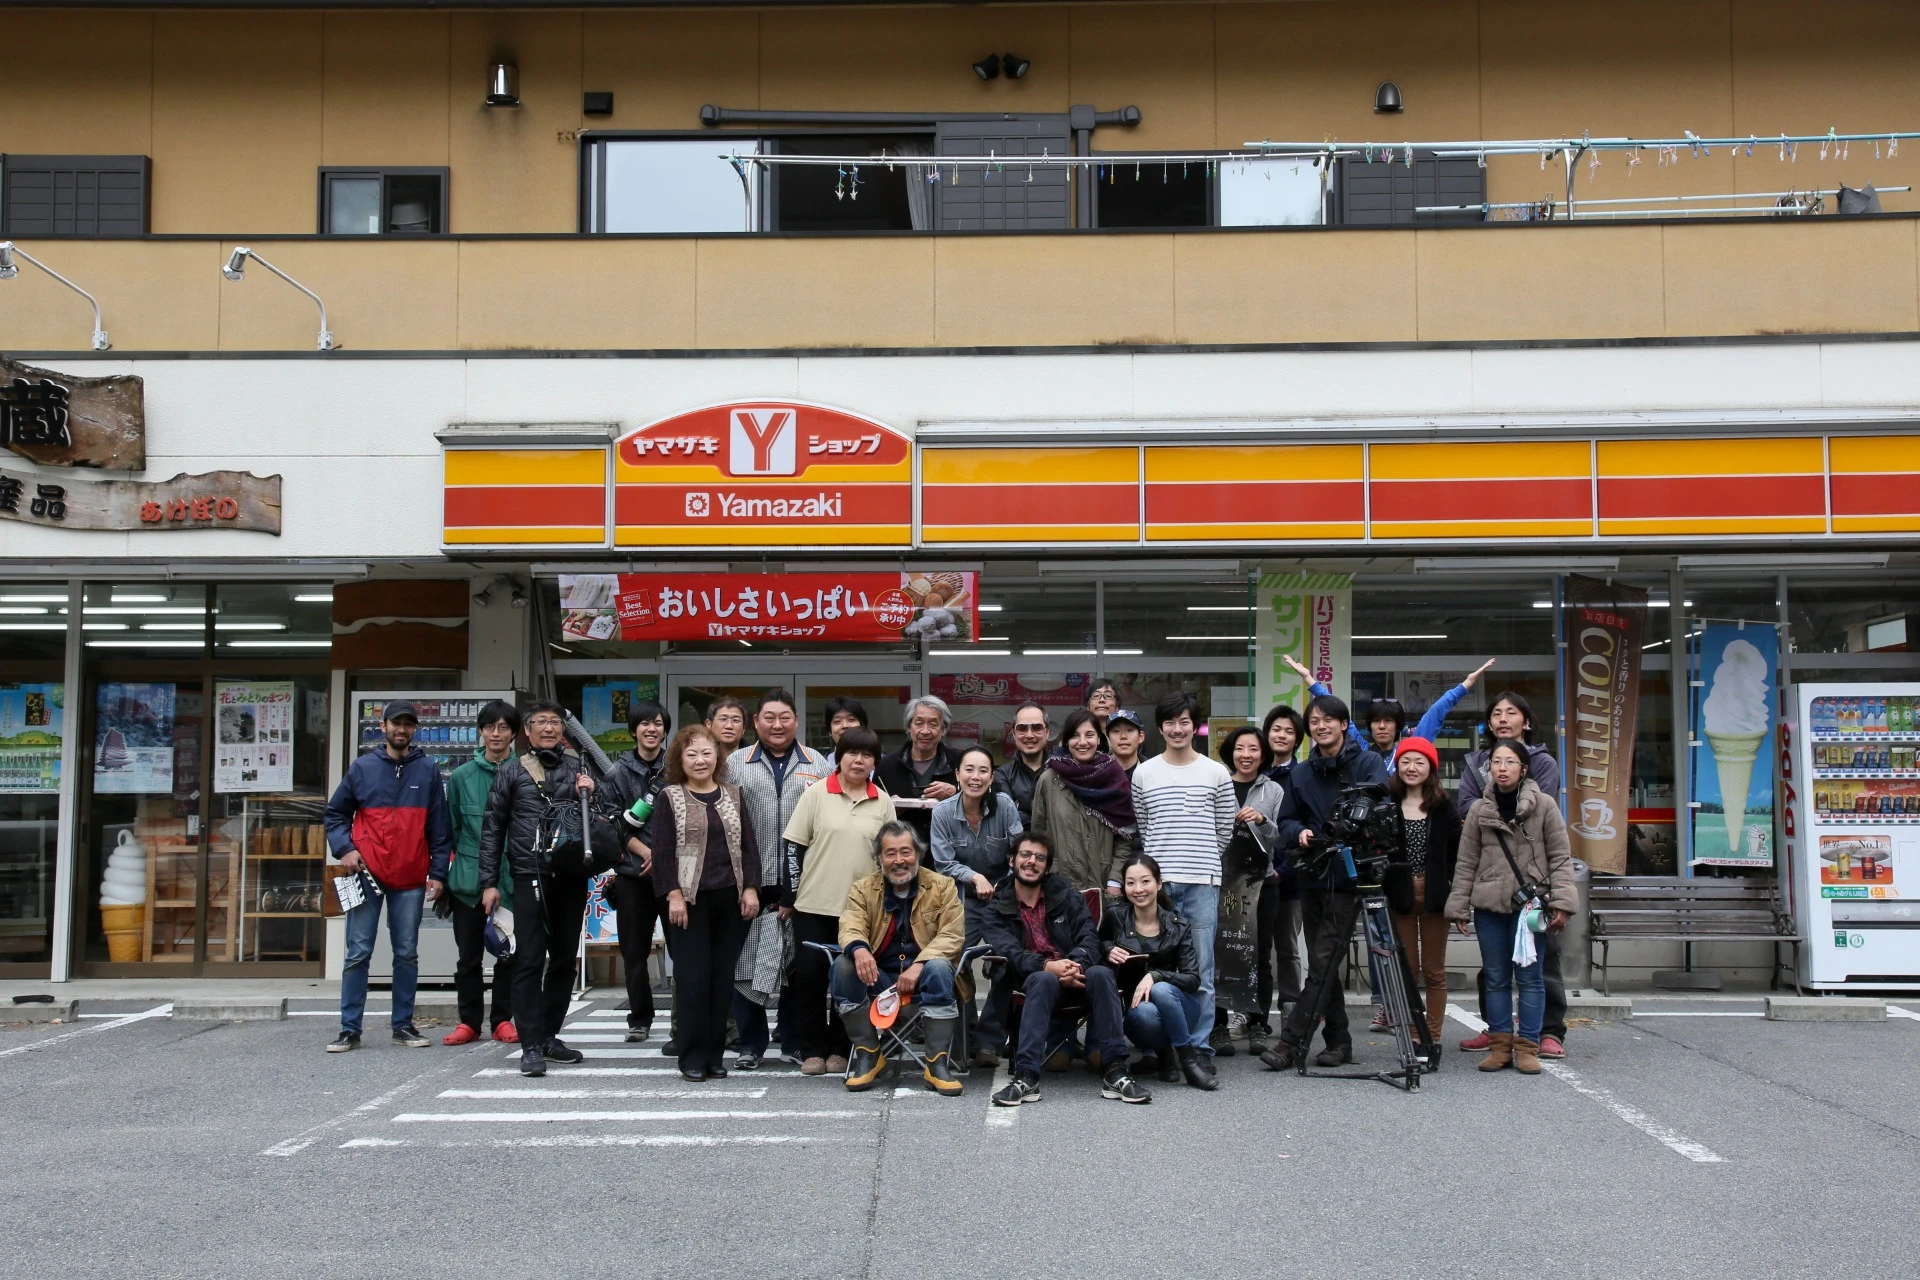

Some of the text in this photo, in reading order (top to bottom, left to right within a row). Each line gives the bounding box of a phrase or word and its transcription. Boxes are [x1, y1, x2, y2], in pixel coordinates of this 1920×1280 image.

[632, 436, 720, 455] ヤマザキ
[736, 412, 791, 472] Y
[808, 433, 881, 456] ショップ
[140, 496, 238, 522] あけぼの
[717, 493, 842, 518] Yamazaki
[624, 601, 642, 610] Best
[658, 586, 870, 620] おいしさいっぱい
[880, 602, 909, 615] ご予約
[618, 608, 650, 619] Selection
[879, 612, 906, 625] 承り中
[723, 623, 826, 637] ヤマザキショップ
[219, 691, 292, 705] 花とみどりのまつり
[1573, 627, 1615, 794] COFFEE
